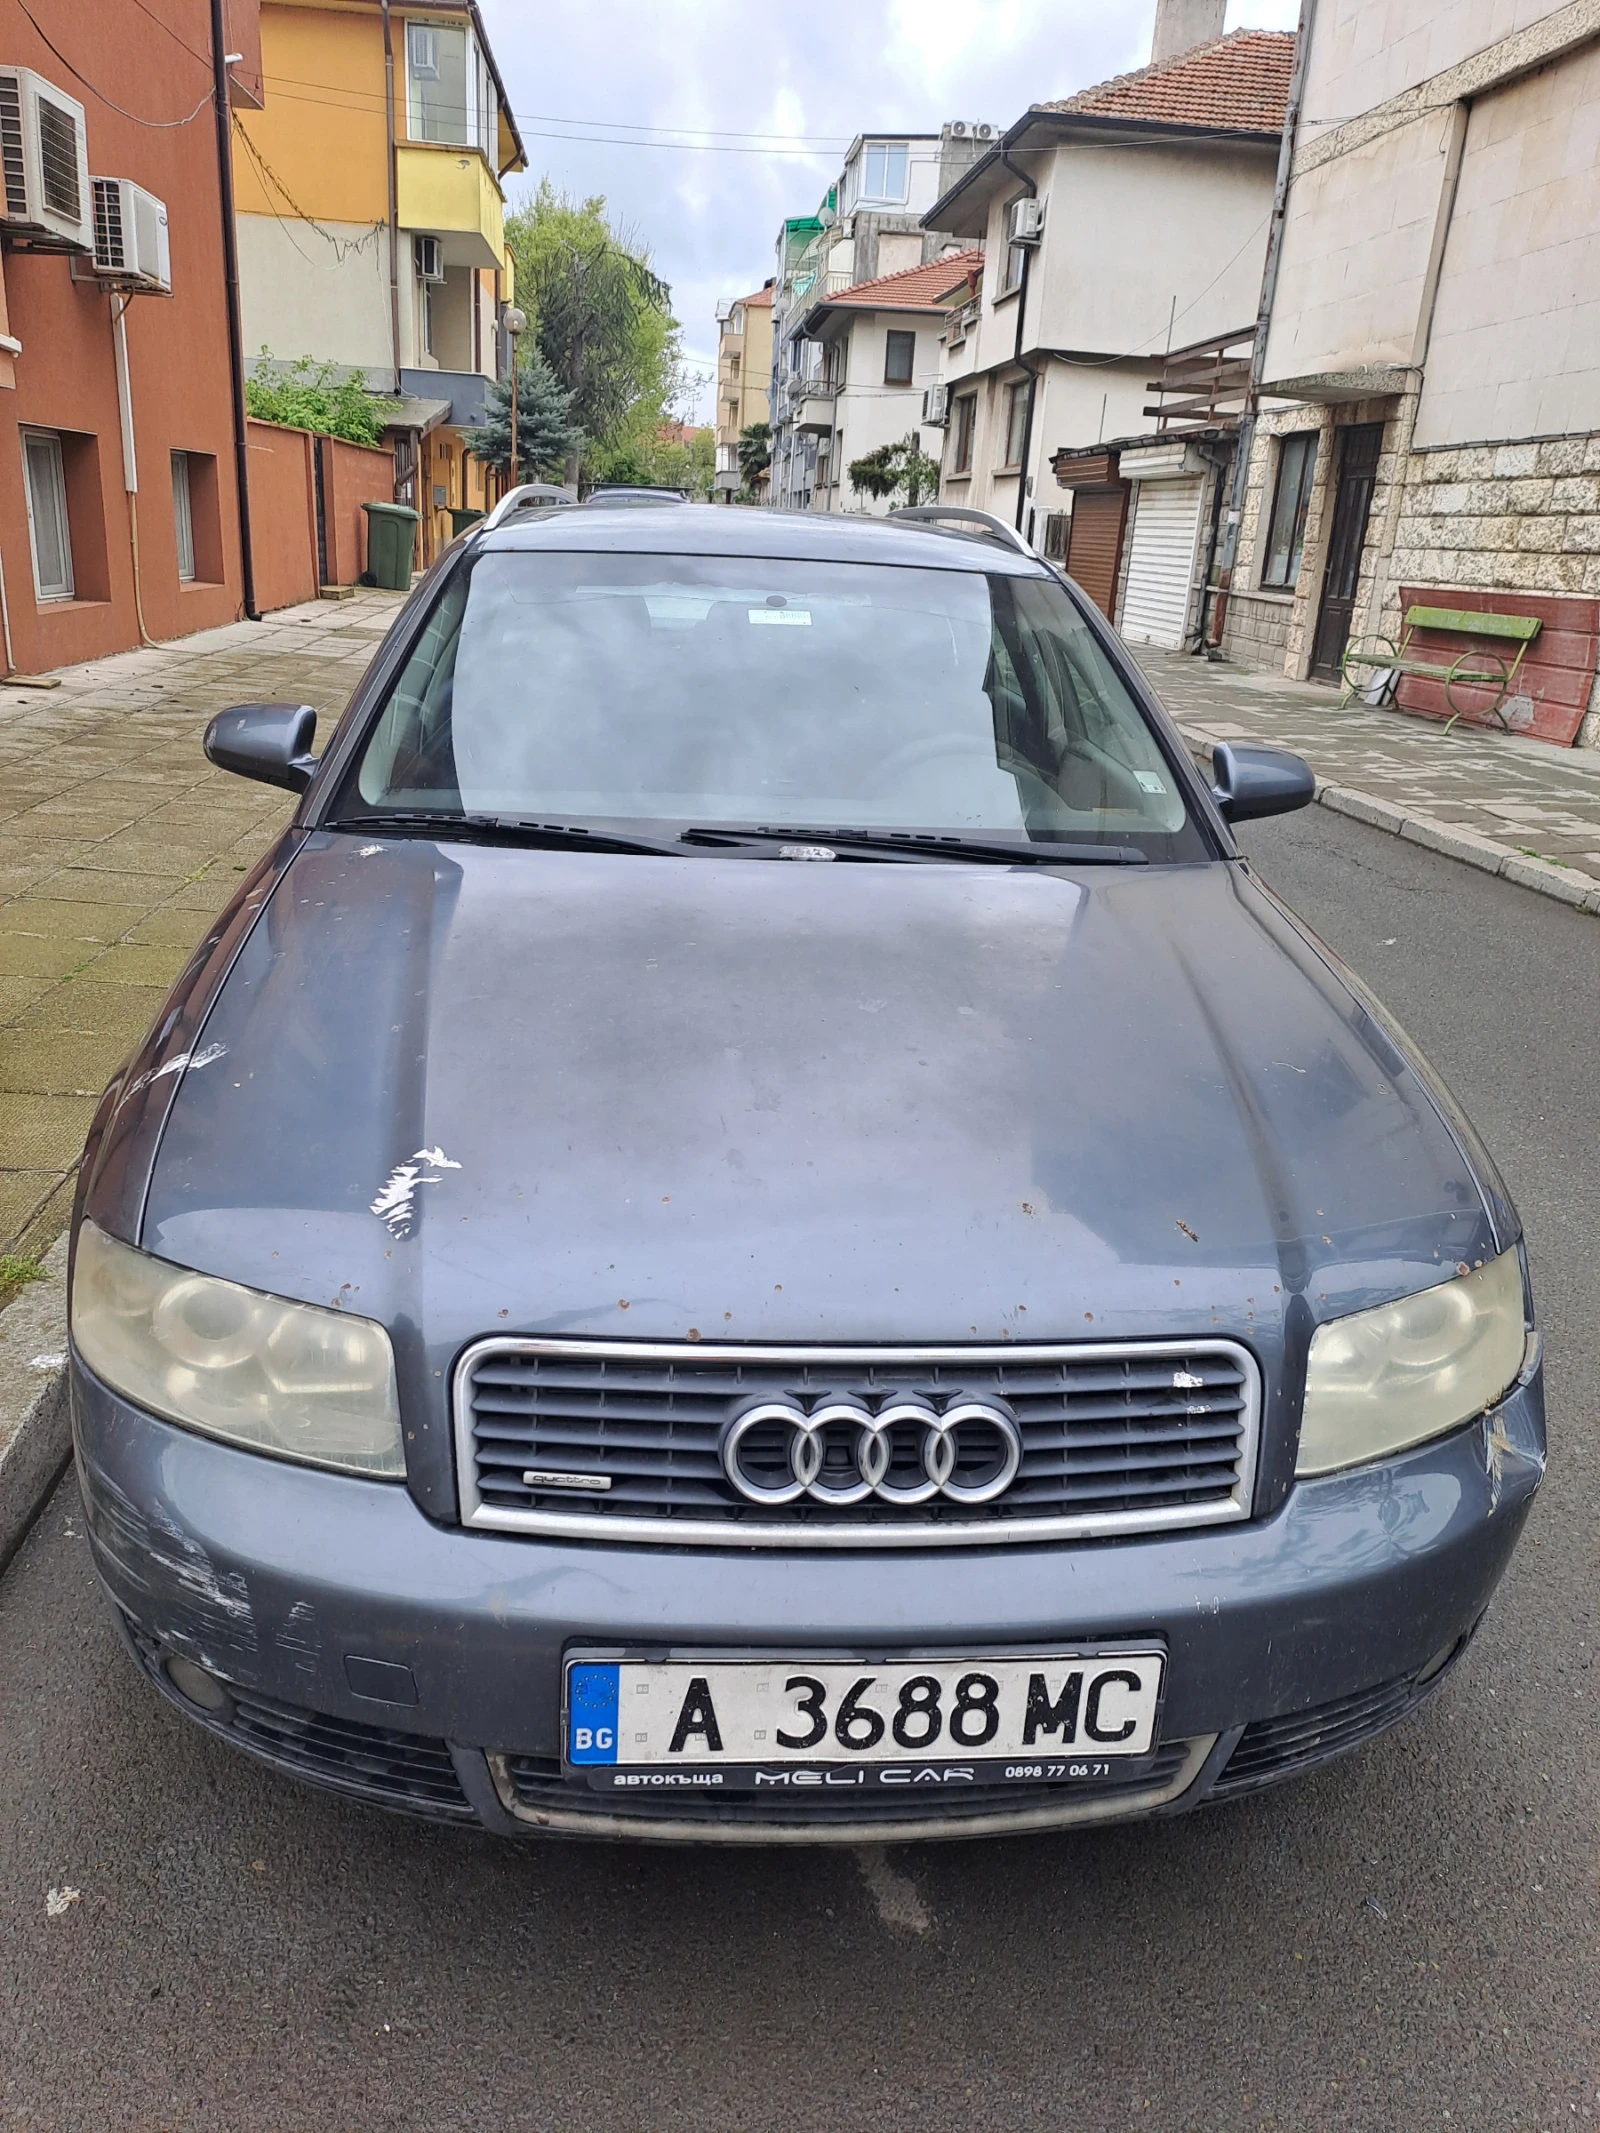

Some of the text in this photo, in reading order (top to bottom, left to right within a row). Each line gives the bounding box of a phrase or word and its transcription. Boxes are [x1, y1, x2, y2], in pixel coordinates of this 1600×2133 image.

[533, 1475, 601, 1485] quattro
[668, 1669, 1142, 1752] A 3688 MC
[575, 1727, 613, 1750] BG
[613, 1772, 724, 1786] автокъща
[754, 1768, 975, 1785] MELI CAR
[1005, 1764, 1110, 1779] 0898 77 06 71
